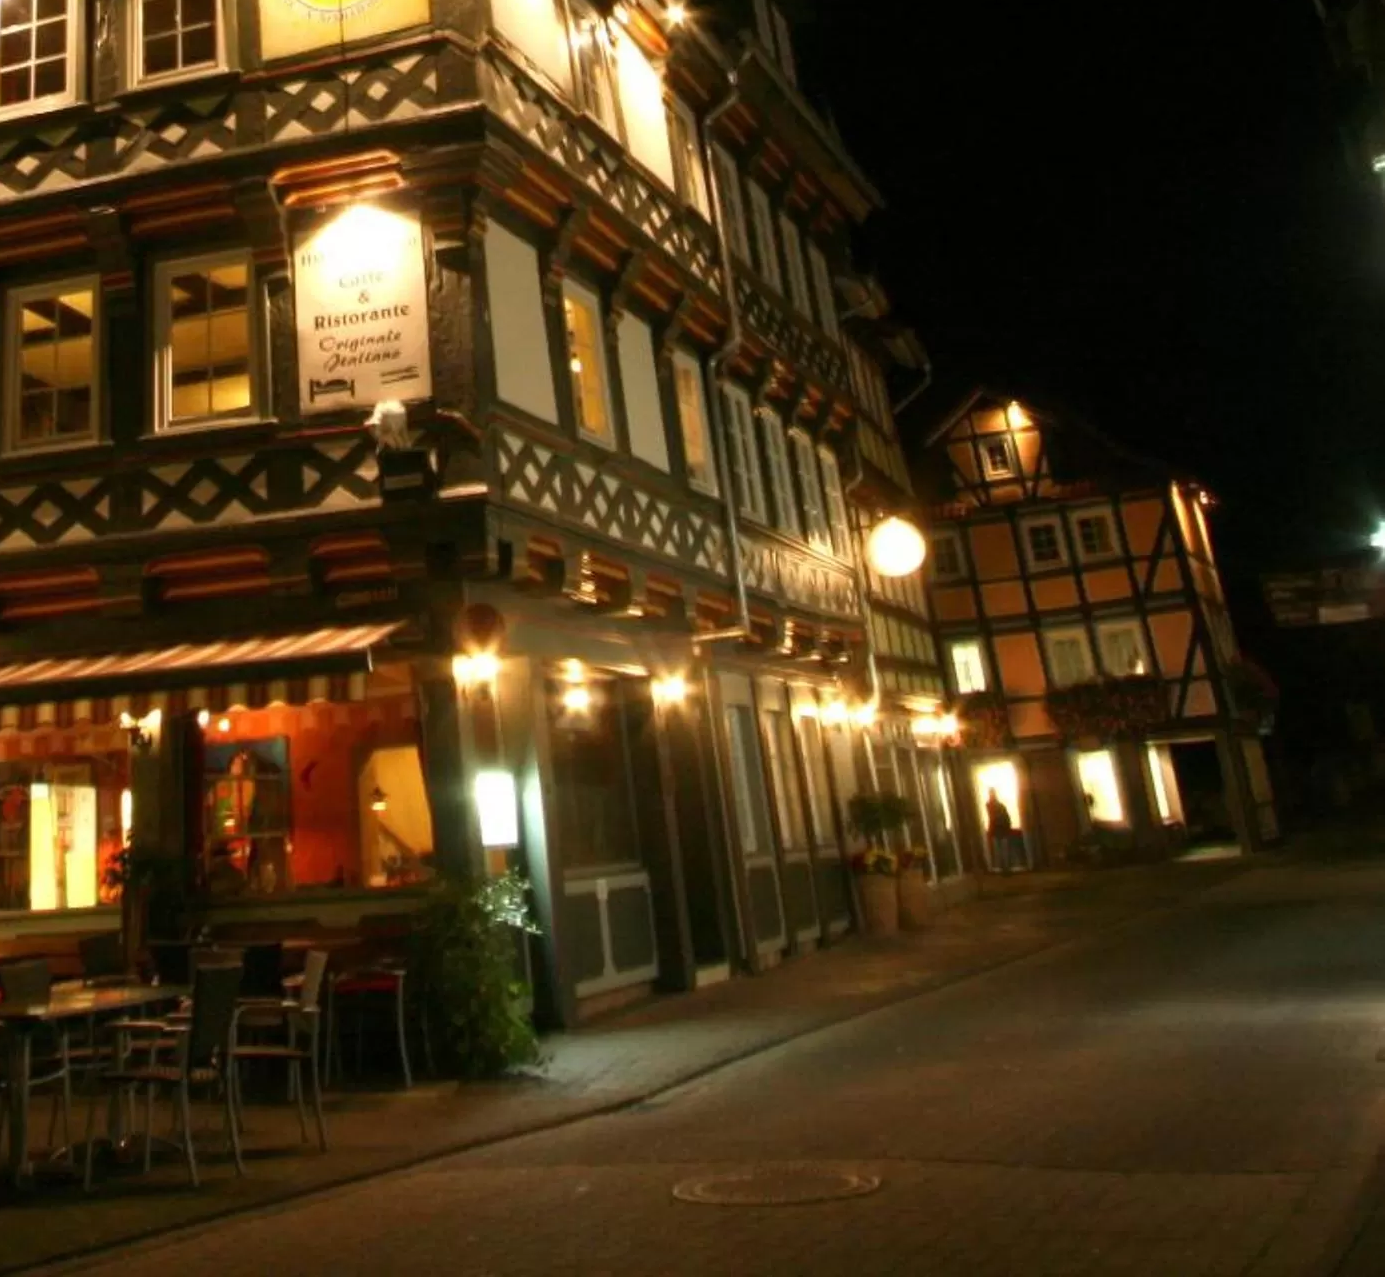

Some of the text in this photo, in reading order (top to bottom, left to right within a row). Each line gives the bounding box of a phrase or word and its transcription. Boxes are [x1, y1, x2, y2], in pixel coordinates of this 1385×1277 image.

[358, 289, 370, 304] &
[314, 304, 410, 331] Ristorante
[319, 328, 402, 352] Originale
